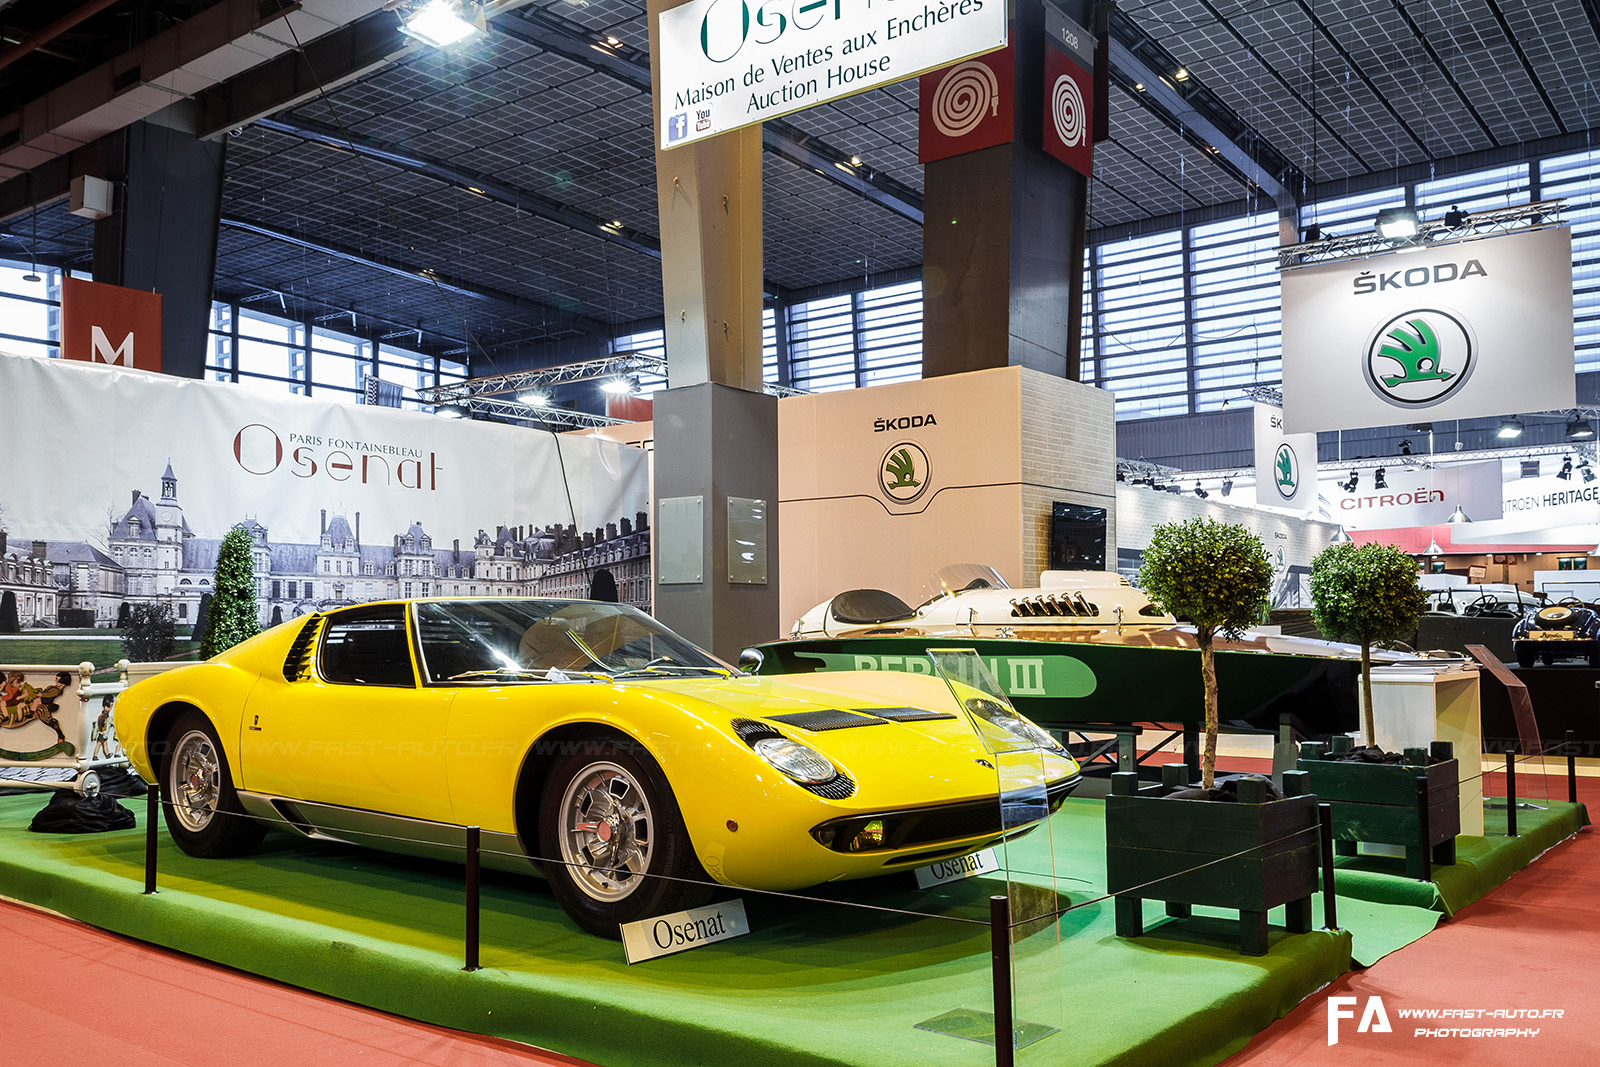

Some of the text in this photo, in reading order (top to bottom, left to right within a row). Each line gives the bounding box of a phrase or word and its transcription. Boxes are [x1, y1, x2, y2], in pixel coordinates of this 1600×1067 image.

[675, 0, 984, 110] Maison de Ventes aux Enchères
[1061, 27, 1079, 50] 1208
[746, 55, 890, 113] Auction House
[696, 109, 711, 120] You
[1353, 259, 1488, 295] ŠKODA
[91, 325, 134, 368] M
[873, 413, 938, 433] ŠKODA
[233, 423, 444, 491] Osenat
[289, 433, 423, 458] PARIS FONTAINEBLEAU
[1502, 486, 1600, 514] ITROEN HERITAGE
[1007, 658, 1046, 695] III
[929, 852, 984, 880] Osenat
[653, 909, 727, 949] Osenat
